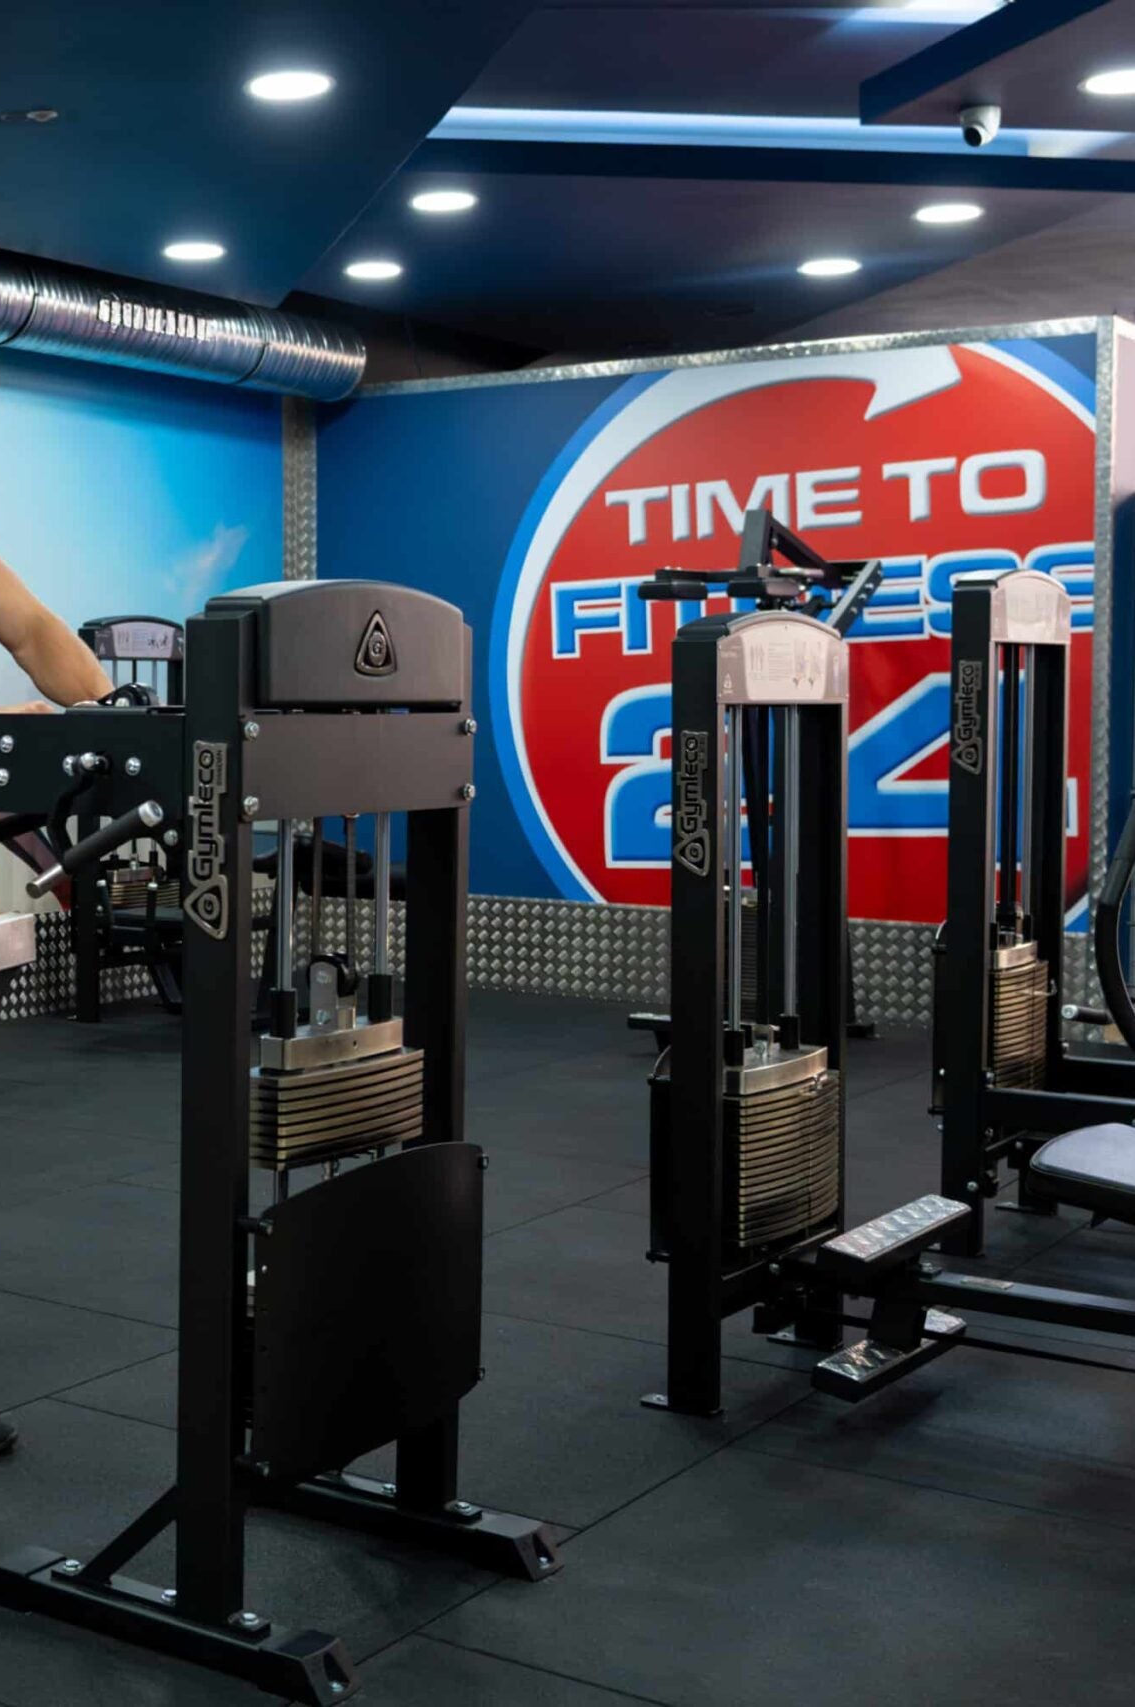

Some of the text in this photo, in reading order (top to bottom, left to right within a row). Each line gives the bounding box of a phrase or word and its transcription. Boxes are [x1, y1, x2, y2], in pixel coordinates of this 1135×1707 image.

[605, 449, 1046, 546] TIME TO
[958, 664, 977, 741] Gymleco
[193, 749, 219, 882] Gymleco
[680, 736, 702, 835] Gymleco
